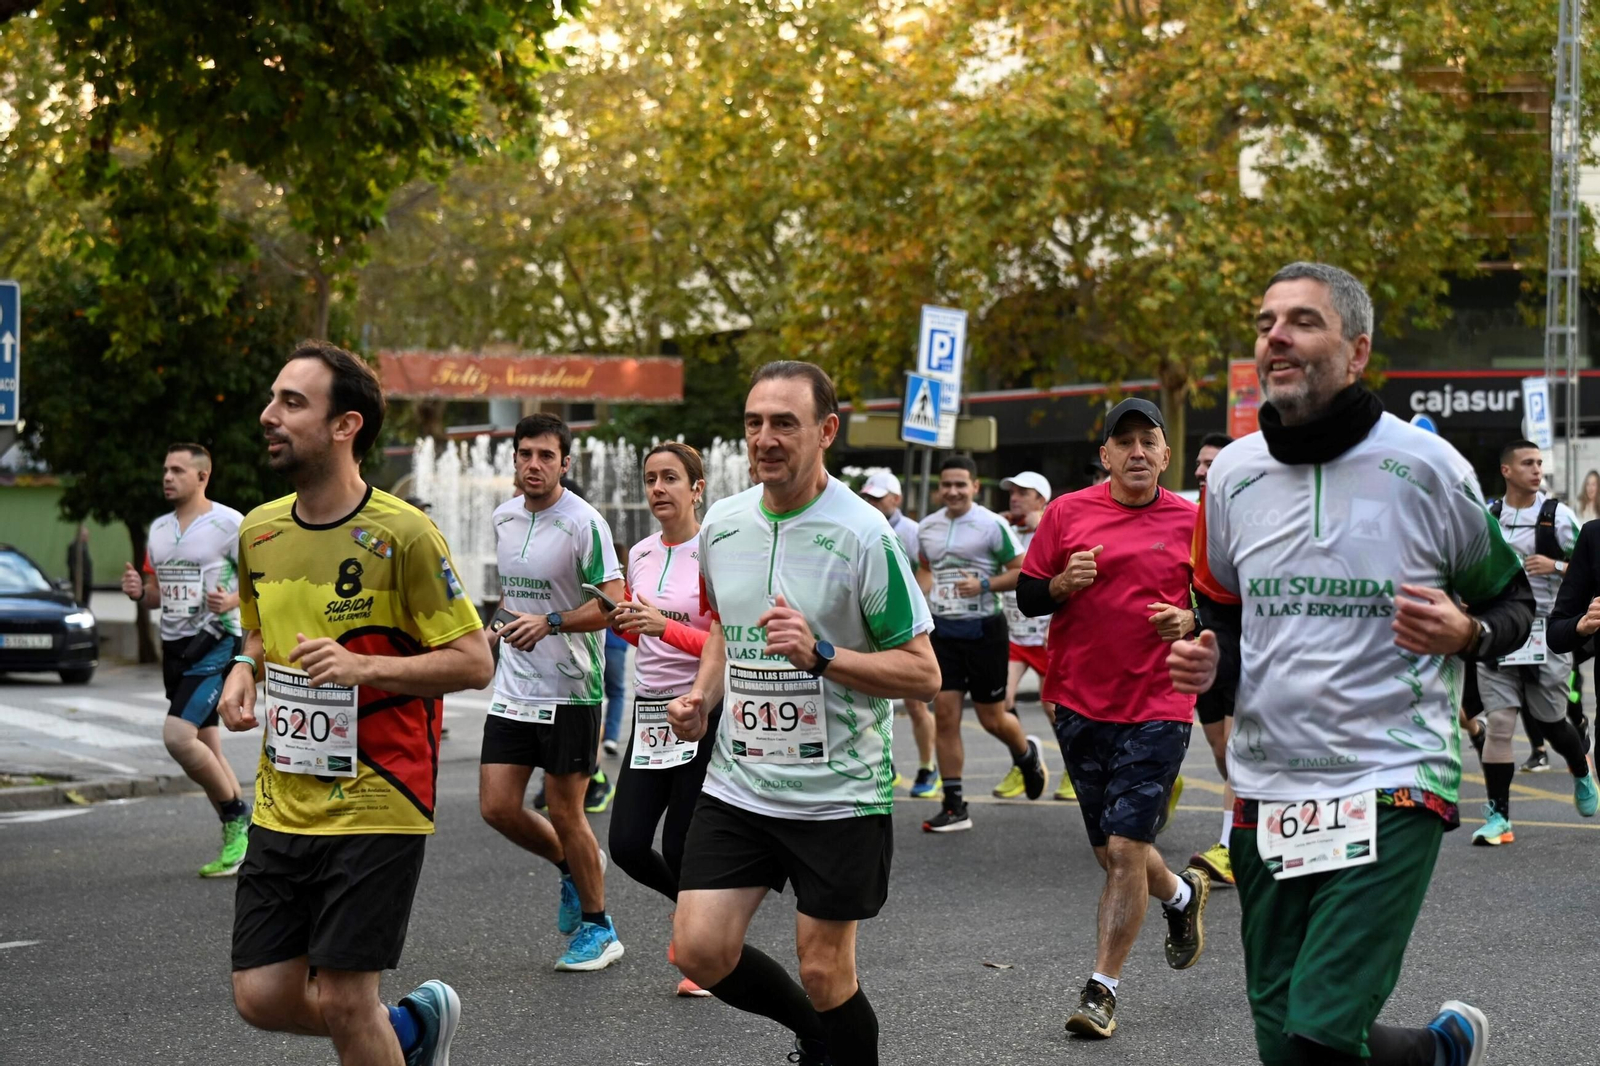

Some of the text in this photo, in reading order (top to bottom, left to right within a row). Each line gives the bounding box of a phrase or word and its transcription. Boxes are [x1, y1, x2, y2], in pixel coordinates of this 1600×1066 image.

[930, 331, 953, 369] P
[432, 361, 595, 394] Feliz Navidad
[1409, 383, 1519, 418] cajasur
[1379, 458, 1411, 478] SIG
[813, 533, 836, 551] SIG
[335, 557, 364, 599] 8
[508, 576, 553, 590] SUBIDA
[1247, 576, 1395, 598] XII SUBIDA
[163, 585, 189, 600] 411
[516, 590, 551, 600] ERMITAS
[324, 596, 374, 615] SUBIDA
[1255, 602, 1394, 618] A LAS ERMITAS
[333, 614, 345, 622] LAS
[346, 611, 372, 620] ERMITAS
[658, 609, 691, 623] BIDA
[734, 647, 757, 659] LAS
[275, 671, 294, 684] SUBIDA
[737, 668, 757, 679] SUBIDA
[758, 670, 763, 680] A
[764, 670, 778, 680] LAS
[745, 680, 774, 691] DONACIÓN
[775, 681, 783, 691] DE
[784, 681, 817, 691] ORGANOS
[308, 690, 316, 699] DE
[317, 691, 352, 701] ORGANOS
[275, 705, 331, 743] 620
[741, 700, 799, 732] 619
[648, 725, 686, 748] 57
[827, 687, 873, 780] Córdob
[1301, 754, 1358, 768] IMDECO
[1279, 797, 1346, 839] 621
